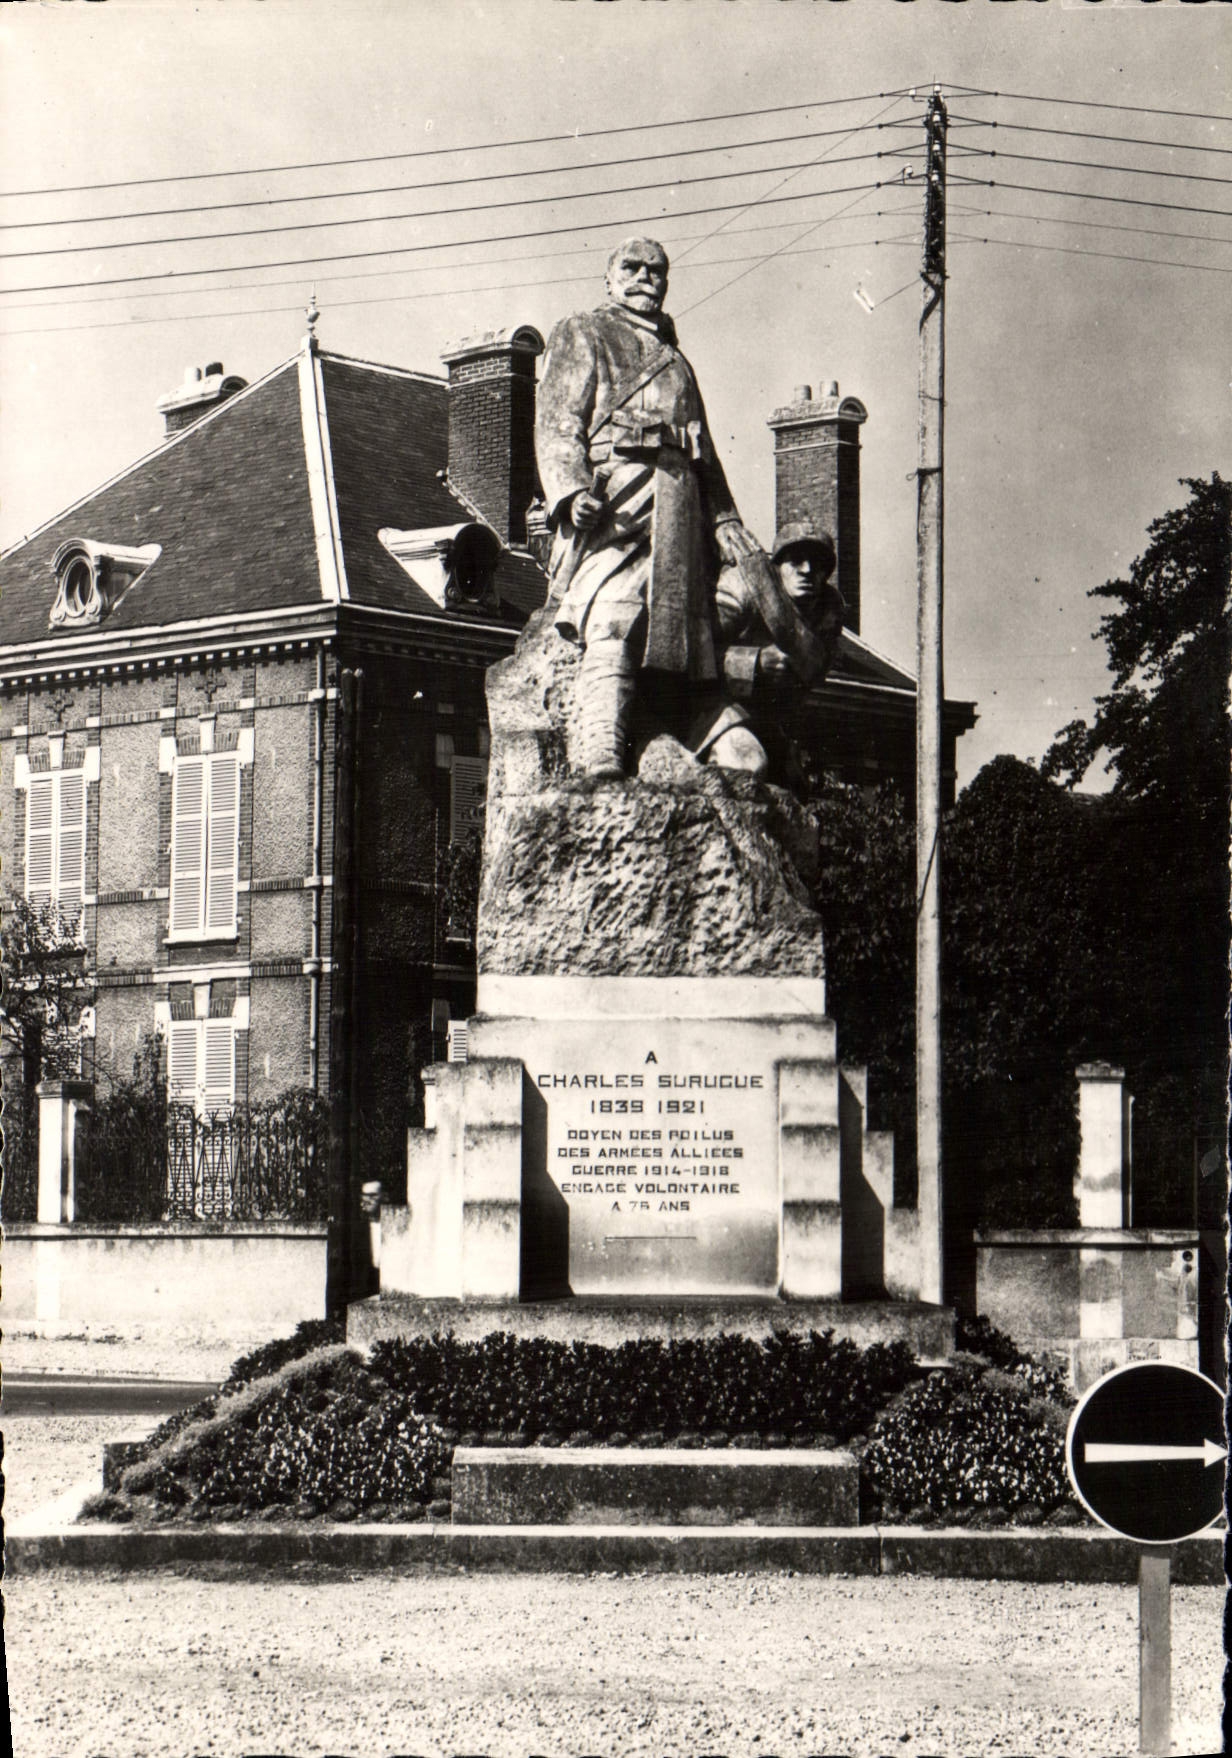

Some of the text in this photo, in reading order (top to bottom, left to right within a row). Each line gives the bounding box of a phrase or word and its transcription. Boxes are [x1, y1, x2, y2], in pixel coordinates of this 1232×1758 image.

[645, 1050, 658, 1065] A
[537, 1074, 764, 1089] CHARLES SURUGUE
[591, 1100, 705, 1114] 1839 1921
[567, 1129, 734, 1141] DOYEN DES POILUS
[557, 1147, 590, 1158] DES
[572, 1165, 730, 1177] GUERRE 1914-1918
[635, 1183, 740, 1194] VOLONTAIRE
[658, 1200, 690, 1212] ANS
